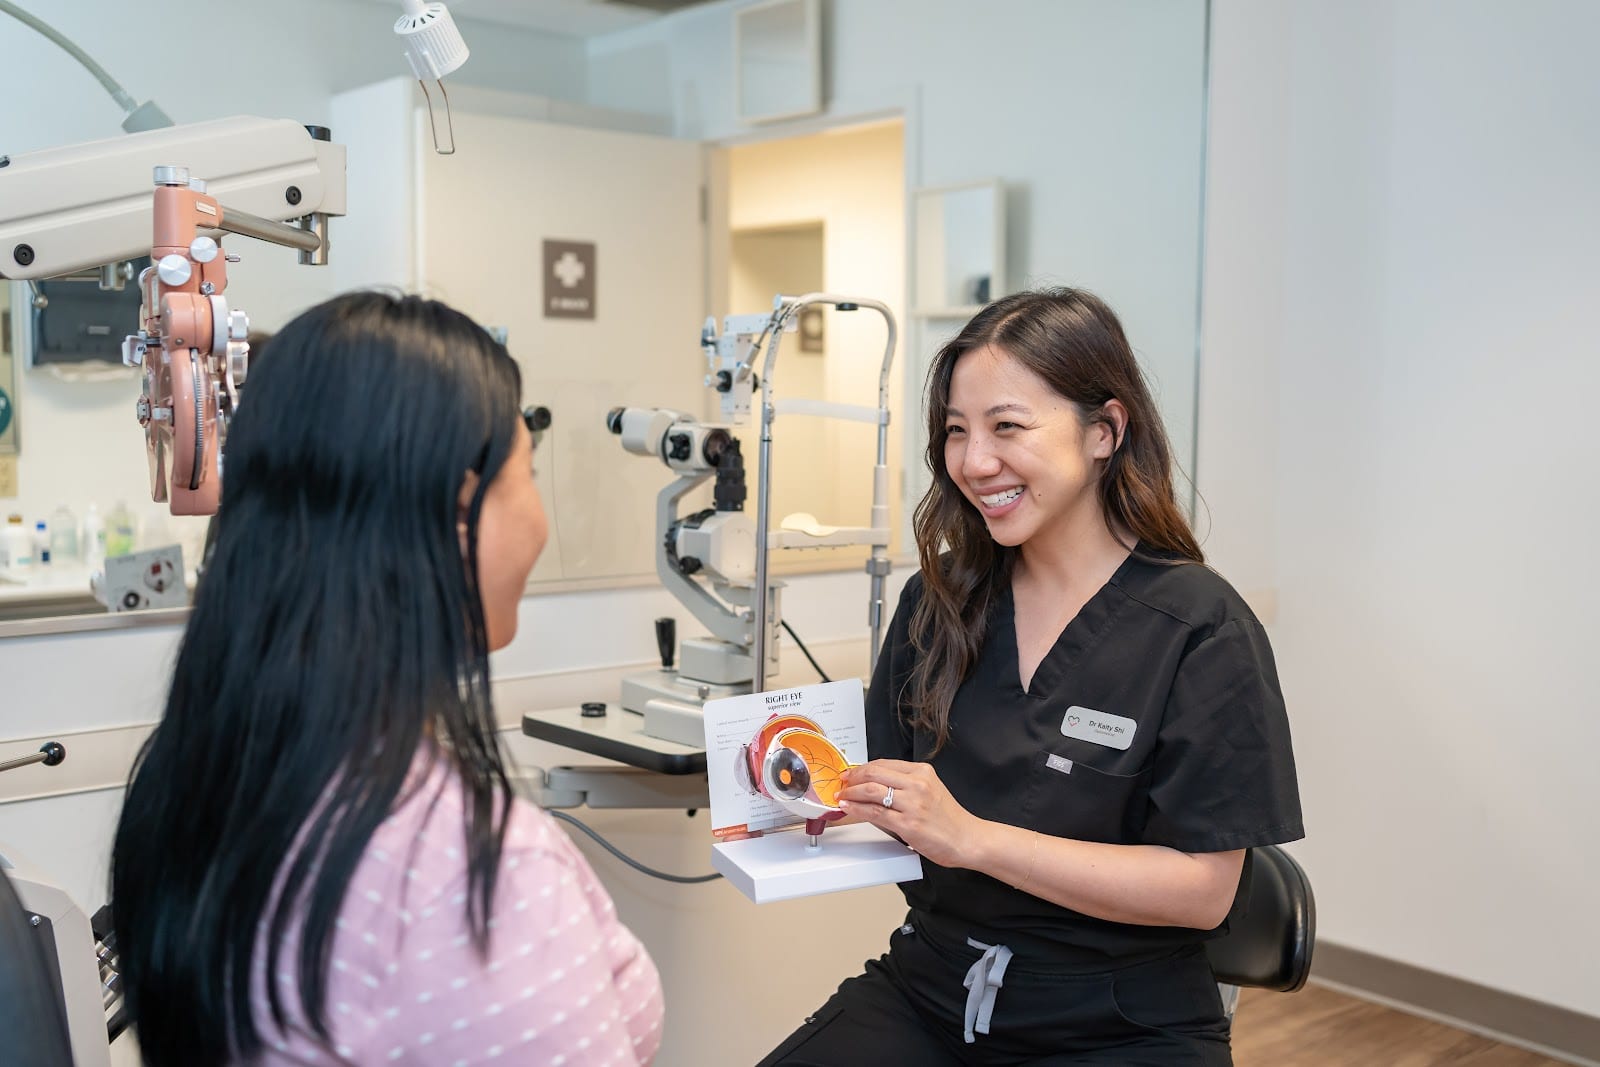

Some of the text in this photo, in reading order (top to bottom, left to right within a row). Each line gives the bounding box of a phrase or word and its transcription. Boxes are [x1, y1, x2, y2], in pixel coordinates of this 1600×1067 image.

[765, 691, 803, 704] RIGHT EYE
[768, 702, 788, 711] superior
[1114, 726, 1125, 735] Shi
